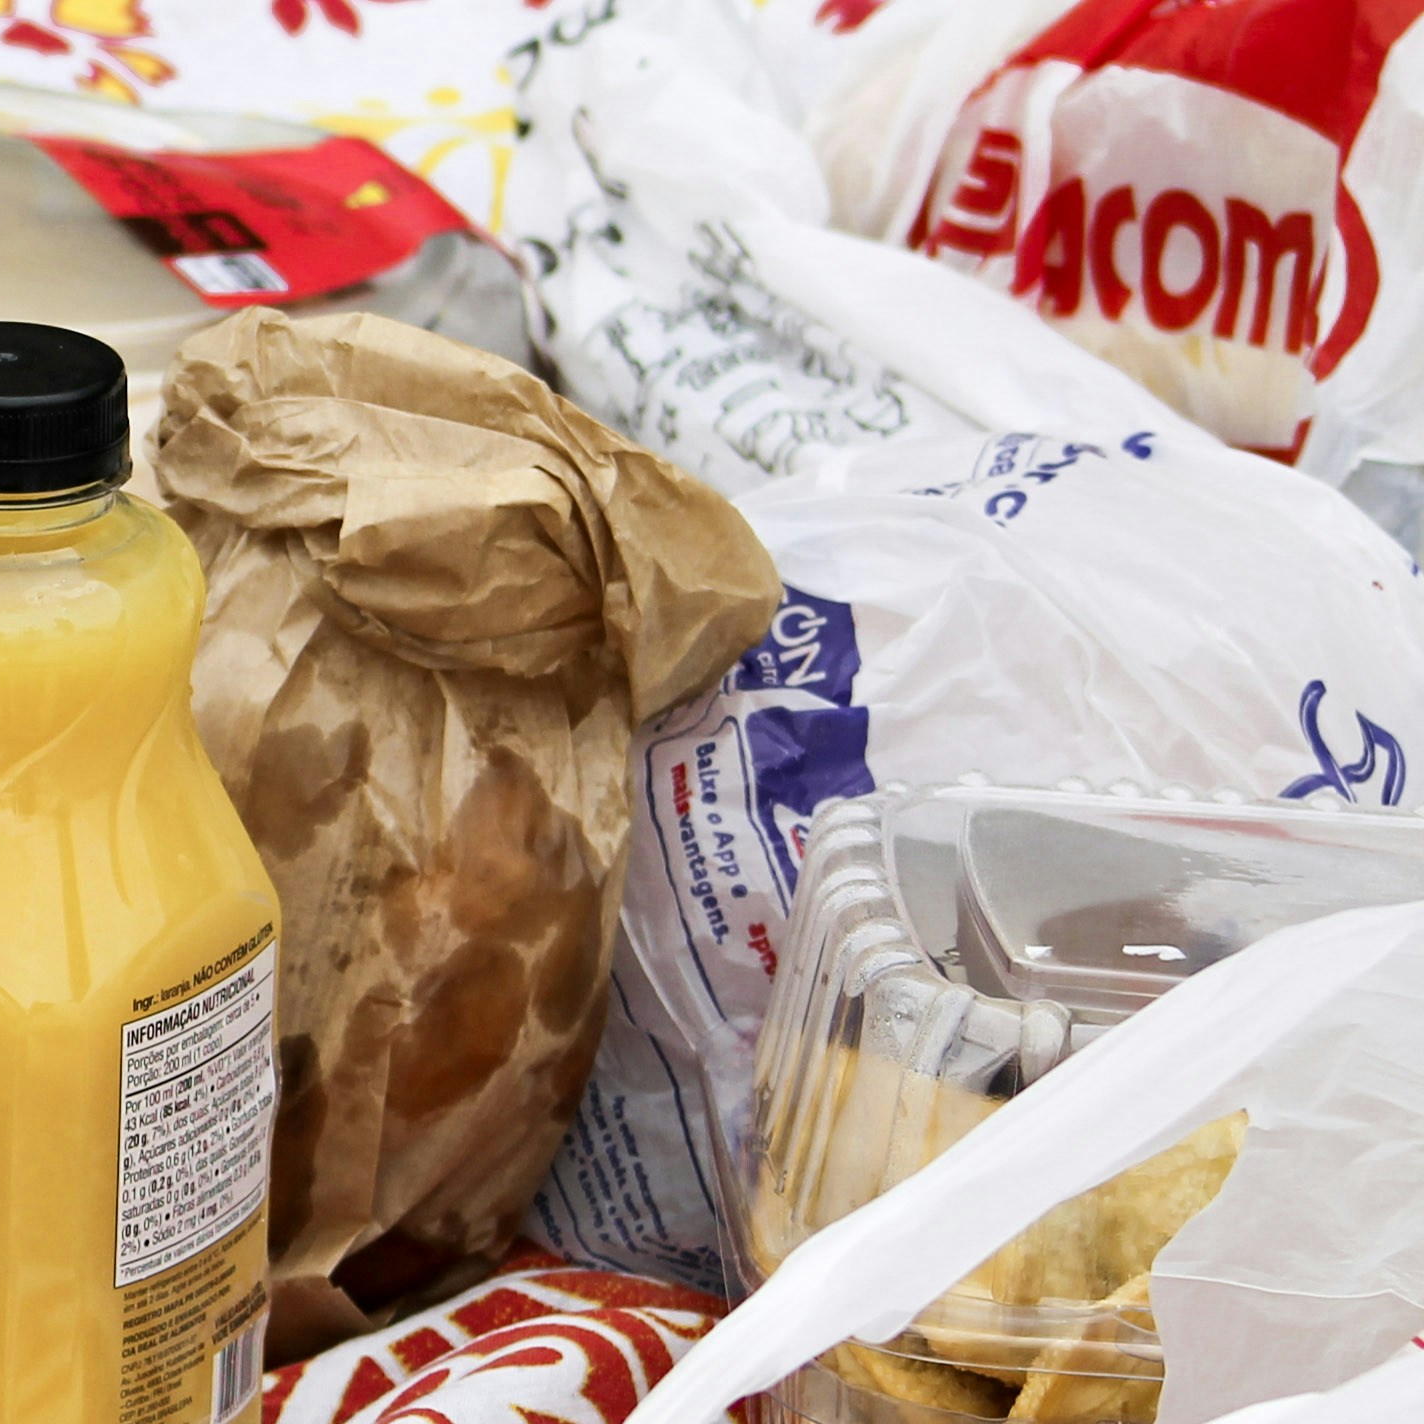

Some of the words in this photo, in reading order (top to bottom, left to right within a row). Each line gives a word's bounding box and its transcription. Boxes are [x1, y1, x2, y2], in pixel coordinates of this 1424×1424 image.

[713, 831, 739, 876] App
[192, 964, 213, 986] NÃO
[214, 942, 248, 974] CONTÉM
[126, 1002, 200, 1046] INFORMAÇÃO
[201, 968, 254, 1014] NUTRICIONAL
[126, 1049, 164, 1072] Porções
[165, 1041, 179, 1061] por
[225, 1005, 242, 1025] cerca
[242, 999, 250, 1013] de
[126, 1067, 160, 1088] Porção:
[163, 1056, 180, 1075] 200
[181, 1050, 192, 1067] ml
[192, 1045, 200, 1062] (1
[202, 1034, 222, 1056] copo)
[124, 1099, 142, 1115] Por
[144, 1089, 161, 1107] 100
[162, 1084, 173, 1100] ml
[175, 1075, 192, 1096] (200
[124, 1116, 137, 1131] 43
[138, 1108, 157, 1127] Kcal
[159, 1102, 173, 1120] (85
[193, 1085, 208, 1102] 4%)
[123, 1133, 140, 1152] (20
[172, 1115, 187, 1131] dos
[137, 1138, 176, 1163] Açúcares
[122, 1161, 164, 1185] Proteínas
[139, 1186, 146, 1200] g
[147, 1175, 165, 1196] (0,2
[120, 1224, 131, 1240] (0
[142, 1212, 162, 1231] 0%)
[172, 1198, 195, 1218] Fibras
[121, 1196, 164, 1221] saturadas
[120, 1238, 141, 1257] 2%)
[152, 1225, 175, 1245] Sódio
[176, 1219, 182, 1234] 2
[183, 1214, 196, 1229] mg
[163, 1252, 171, 1262] de
